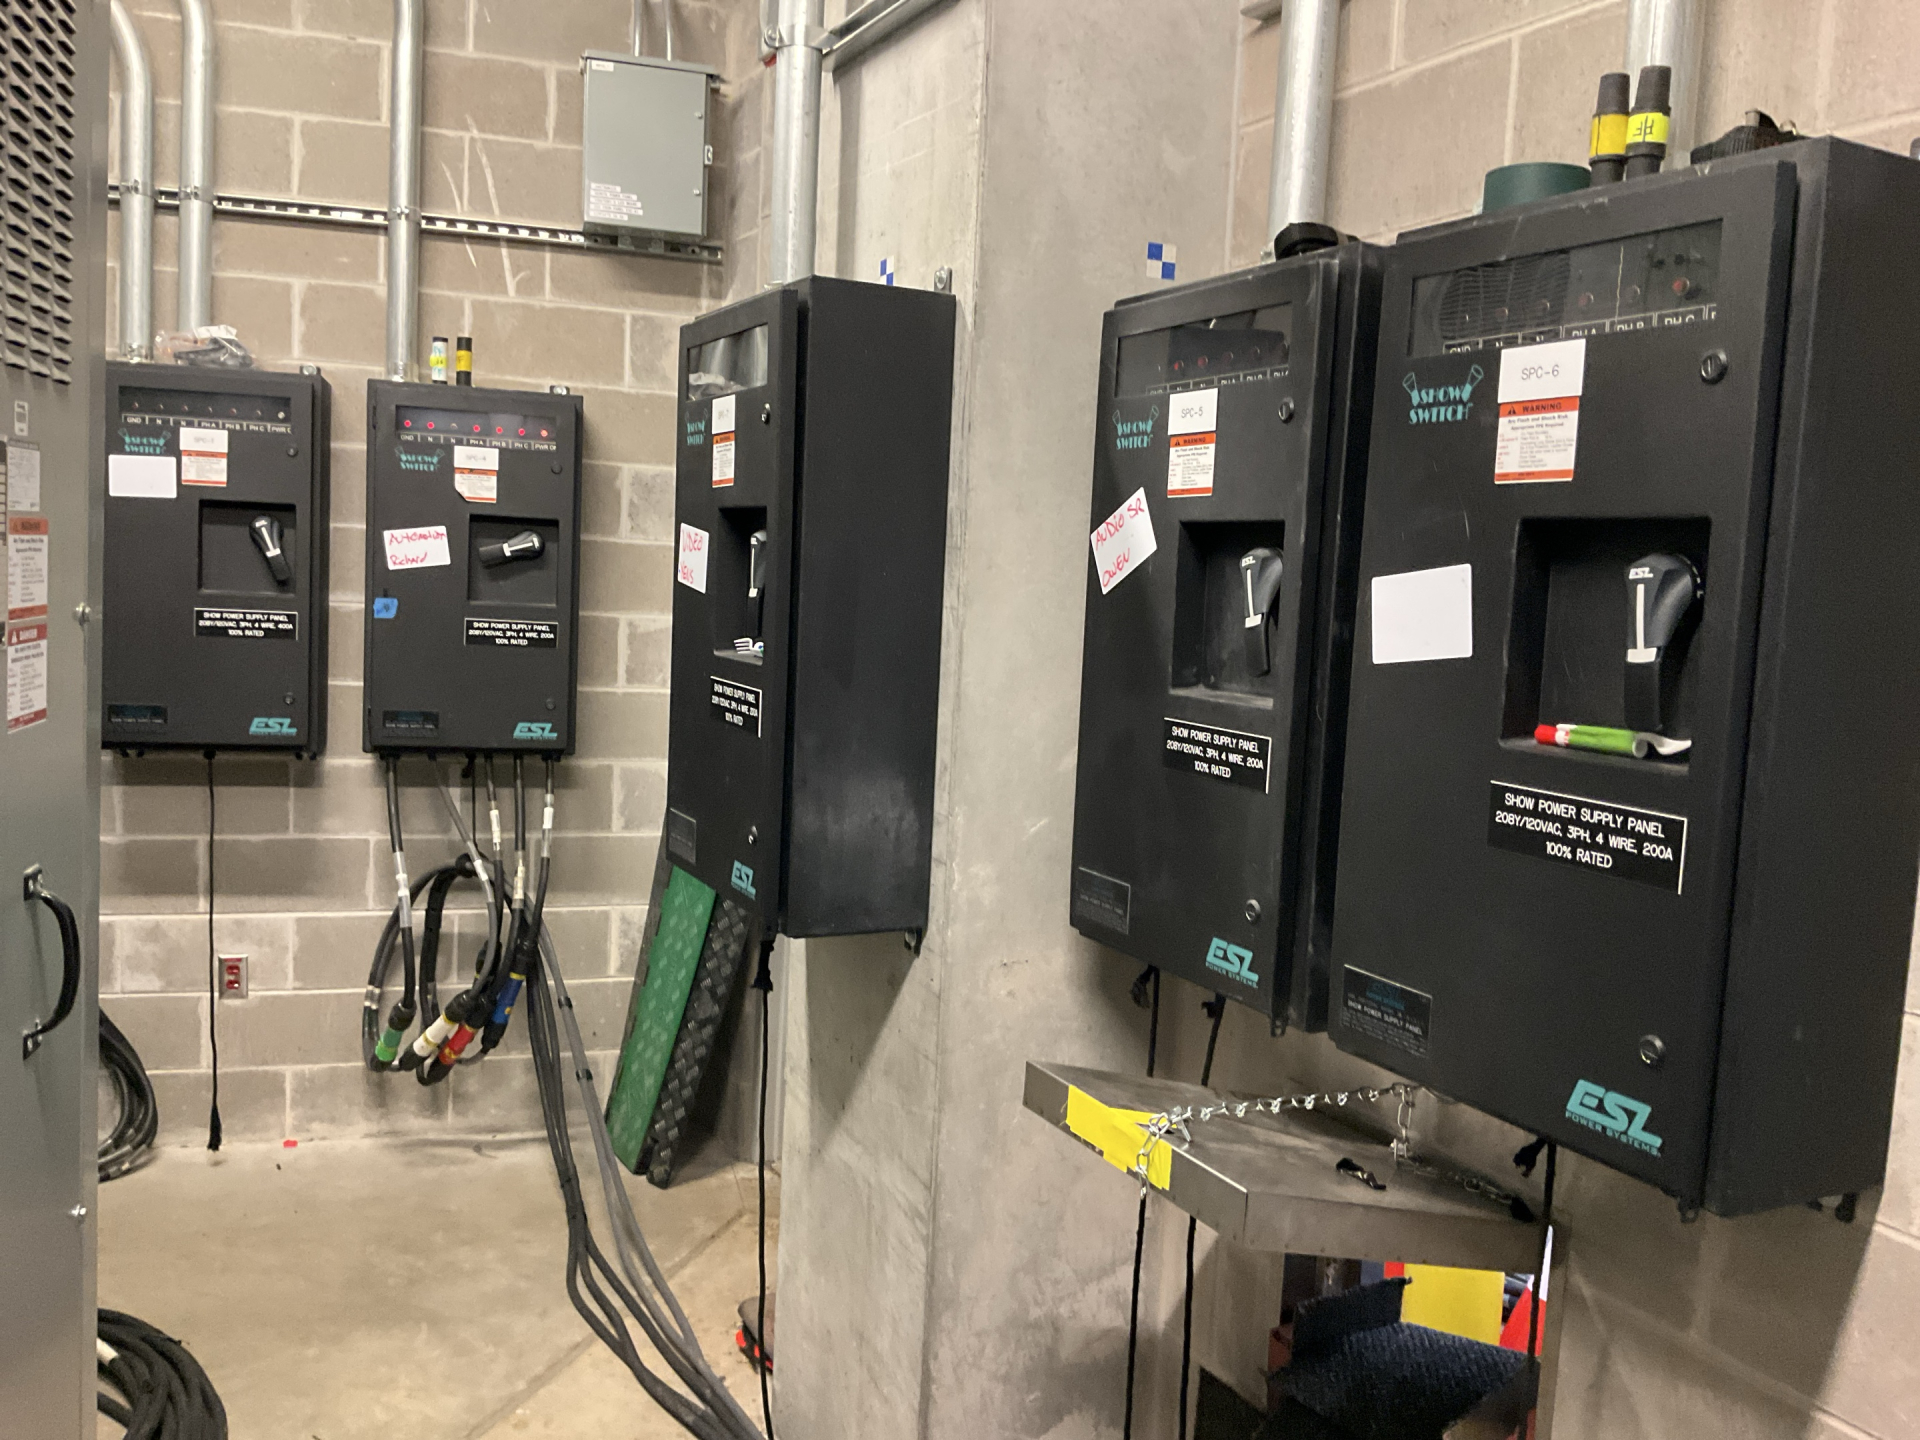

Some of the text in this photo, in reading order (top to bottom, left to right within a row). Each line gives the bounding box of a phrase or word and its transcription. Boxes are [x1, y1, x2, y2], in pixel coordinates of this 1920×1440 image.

[1520, 364, 1560, 381] SPC-6
[1418, 385, 1465, 404] SHOW
[1181, 406, 1204, 419] SPC-5
[1408, 404, 1470, 425] SWITCH
[1522, 402, 1562, 413] WARNING
[1127, 497, 1145, 519] SR
[1629, 567, 1654, 579] ESL
[249, 717, 297, 733] ESL
[513, 722, 558, 737] ESL
[1171, 726, 1259, 753] SHOW POWER SUPPLY PANEL
[1194, 760, 1231, 778] 100% RATED
[1221, 751, 1226, 761] 4
[1246, 756, 1264, 770] 200A
[1504, 792, 1665, 838] SHOW POWER SUPPLY PANEL
[1495, 810, 1673, 861] 208Y/120VAC, 3PH, 4 WIRE, 200A
[1546, 841, 1613, 868] 100% RATED
[731, 859, 757, 897] ESL
[1205, 936, 1259, 982] ESL
[1205, 961, 1227, 977] POWER
[1566, 1079, 1662, 1149] ESL
[1565, 1109, 1660, 1158] POWER SYSTEMS
